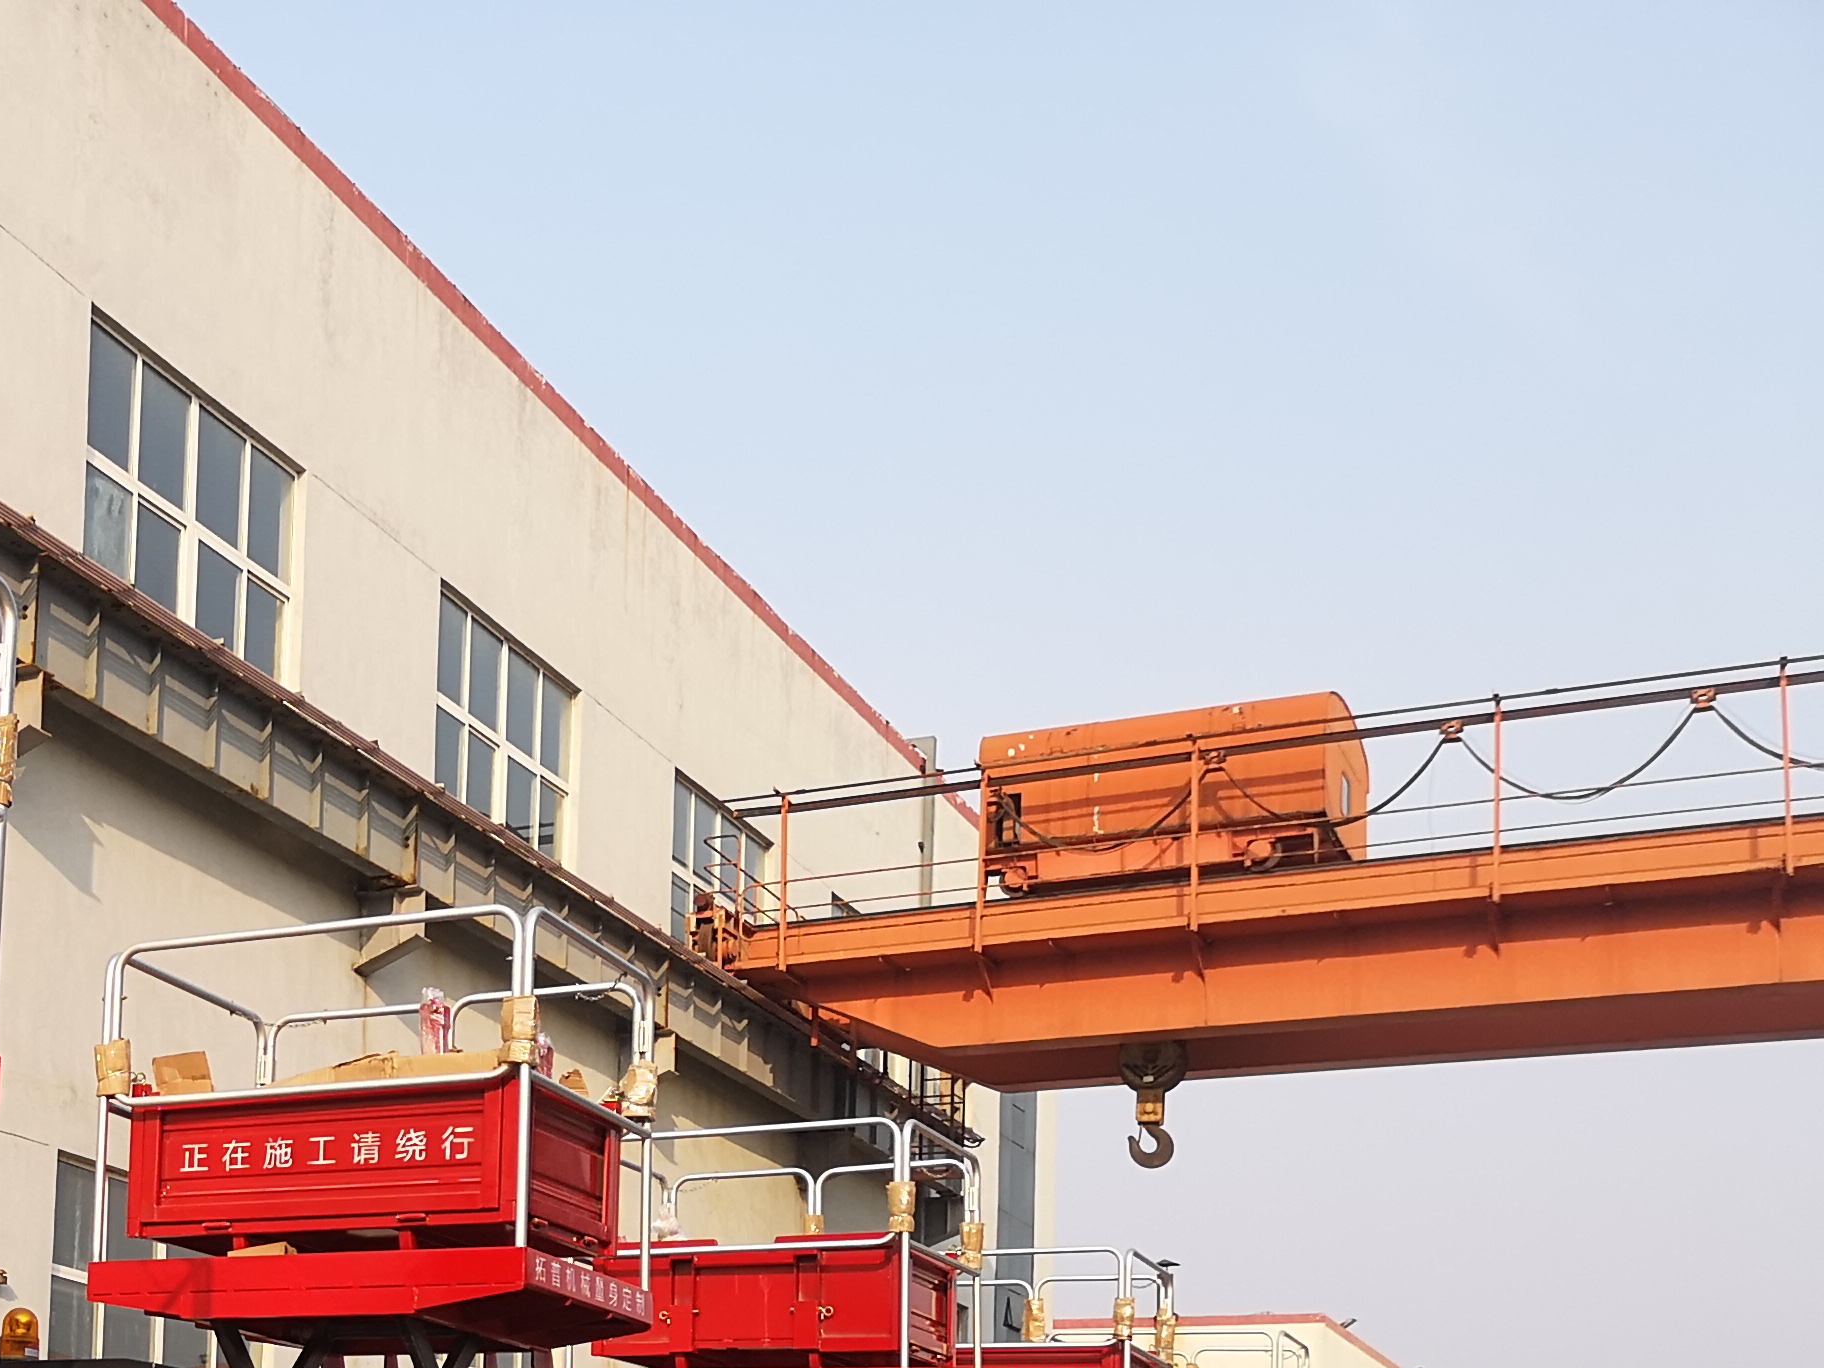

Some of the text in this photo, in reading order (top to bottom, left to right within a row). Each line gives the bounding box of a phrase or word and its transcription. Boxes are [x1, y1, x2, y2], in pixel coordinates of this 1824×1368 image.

[179, 1125, 475, 1173] 正在施工请绕行
[535, 1255, 646, 1317] 拓普机械量身定制
